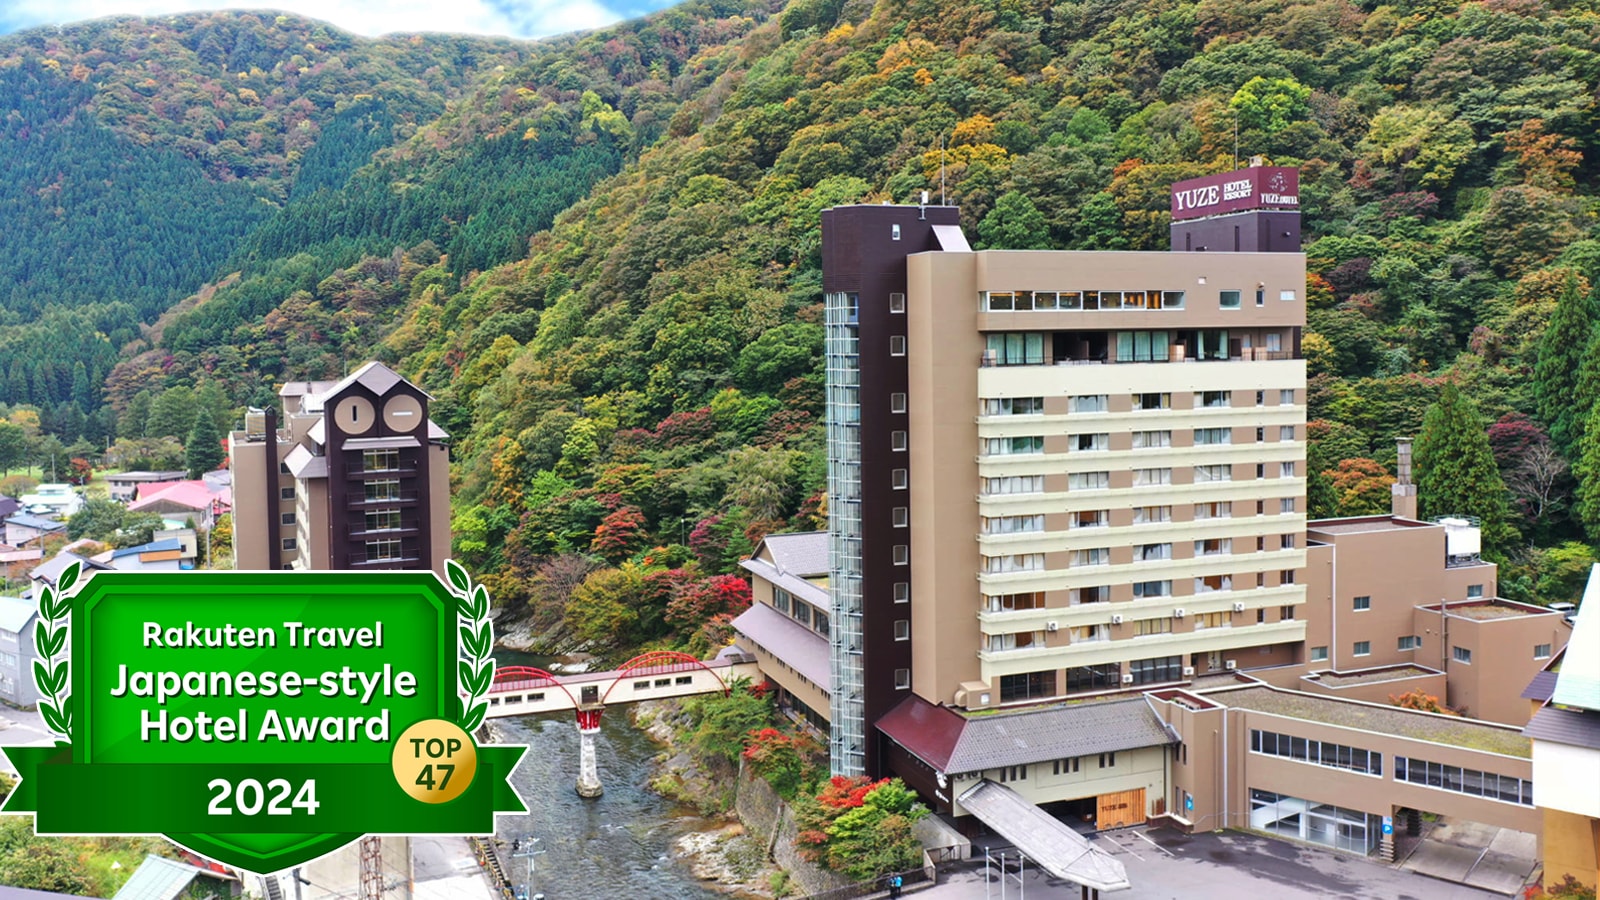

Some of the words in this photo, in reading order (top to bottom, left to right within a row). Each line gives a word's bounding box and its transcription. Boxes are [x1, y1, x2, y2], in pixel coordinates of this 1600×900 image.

[1224, 179, 1252, 192] HOTEL
[1175, 186, 1220, 210] YUZE
[1224, 189, 1252, 201] RESORT
